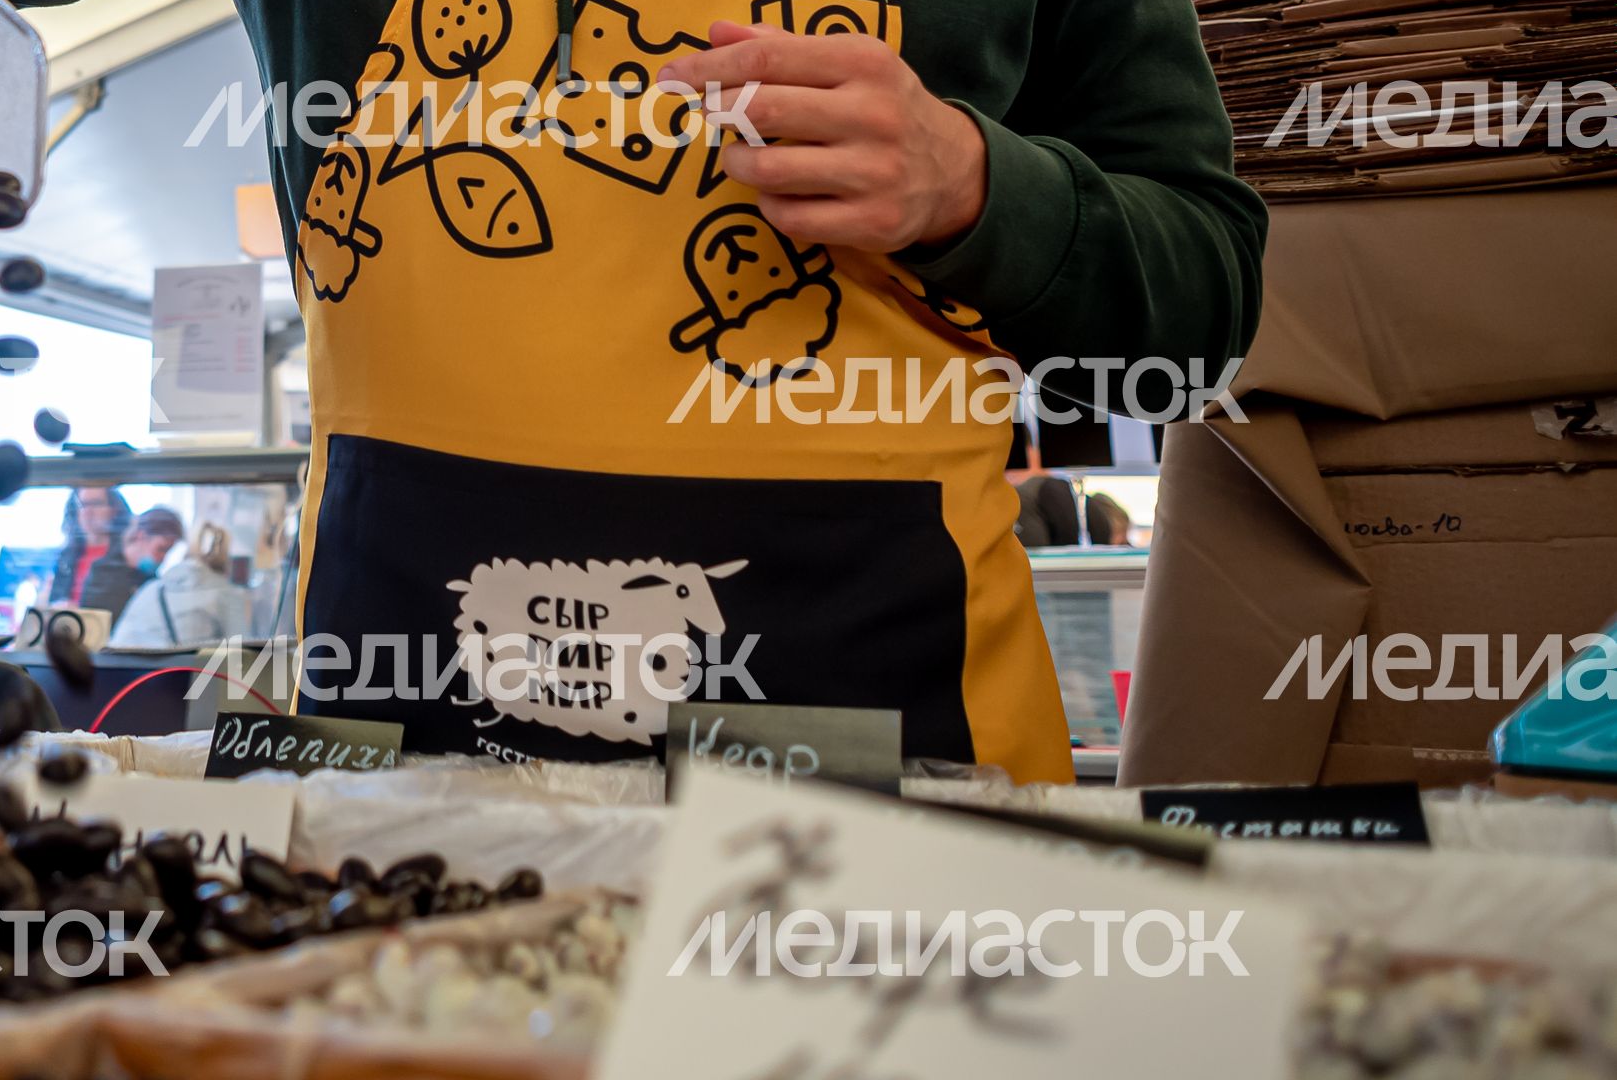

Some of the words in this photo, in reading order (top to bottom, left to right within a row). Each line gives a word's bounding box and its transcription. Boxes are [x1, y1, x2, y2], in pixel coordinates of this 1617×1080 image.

[527, 595, 610, 630] СЫР
[526, 633, 615, 671] ПИР
[526, 676, 612, 710] МИР
[215, 717, 396, 769] Облепиха
[476, 736, 536, 766] гаст
